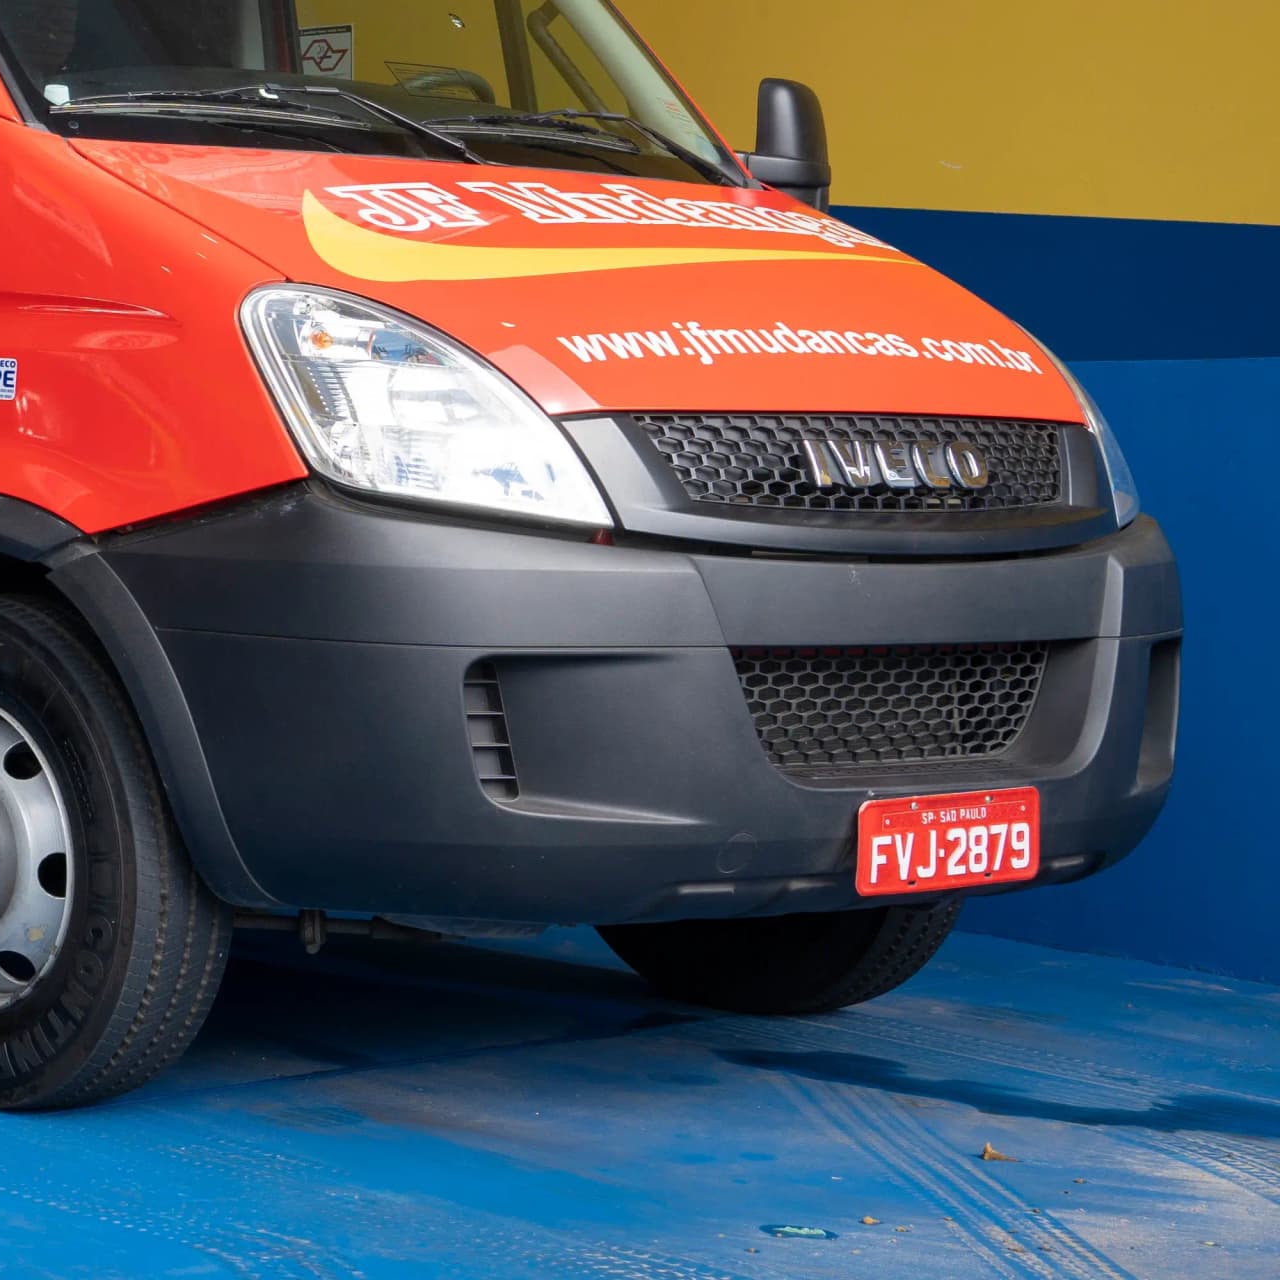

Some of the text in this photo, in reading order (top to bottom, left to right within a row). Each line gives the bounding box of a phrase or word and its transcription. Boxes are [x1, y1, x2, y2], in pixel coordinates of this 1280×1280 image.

[323, 181, 490, 232] JF
[556, 320, 1044, 376] www.jfmudancas.com.br
[803, 439, 989, 488] IVECO
[959, 806, 987, 821] PAULO
